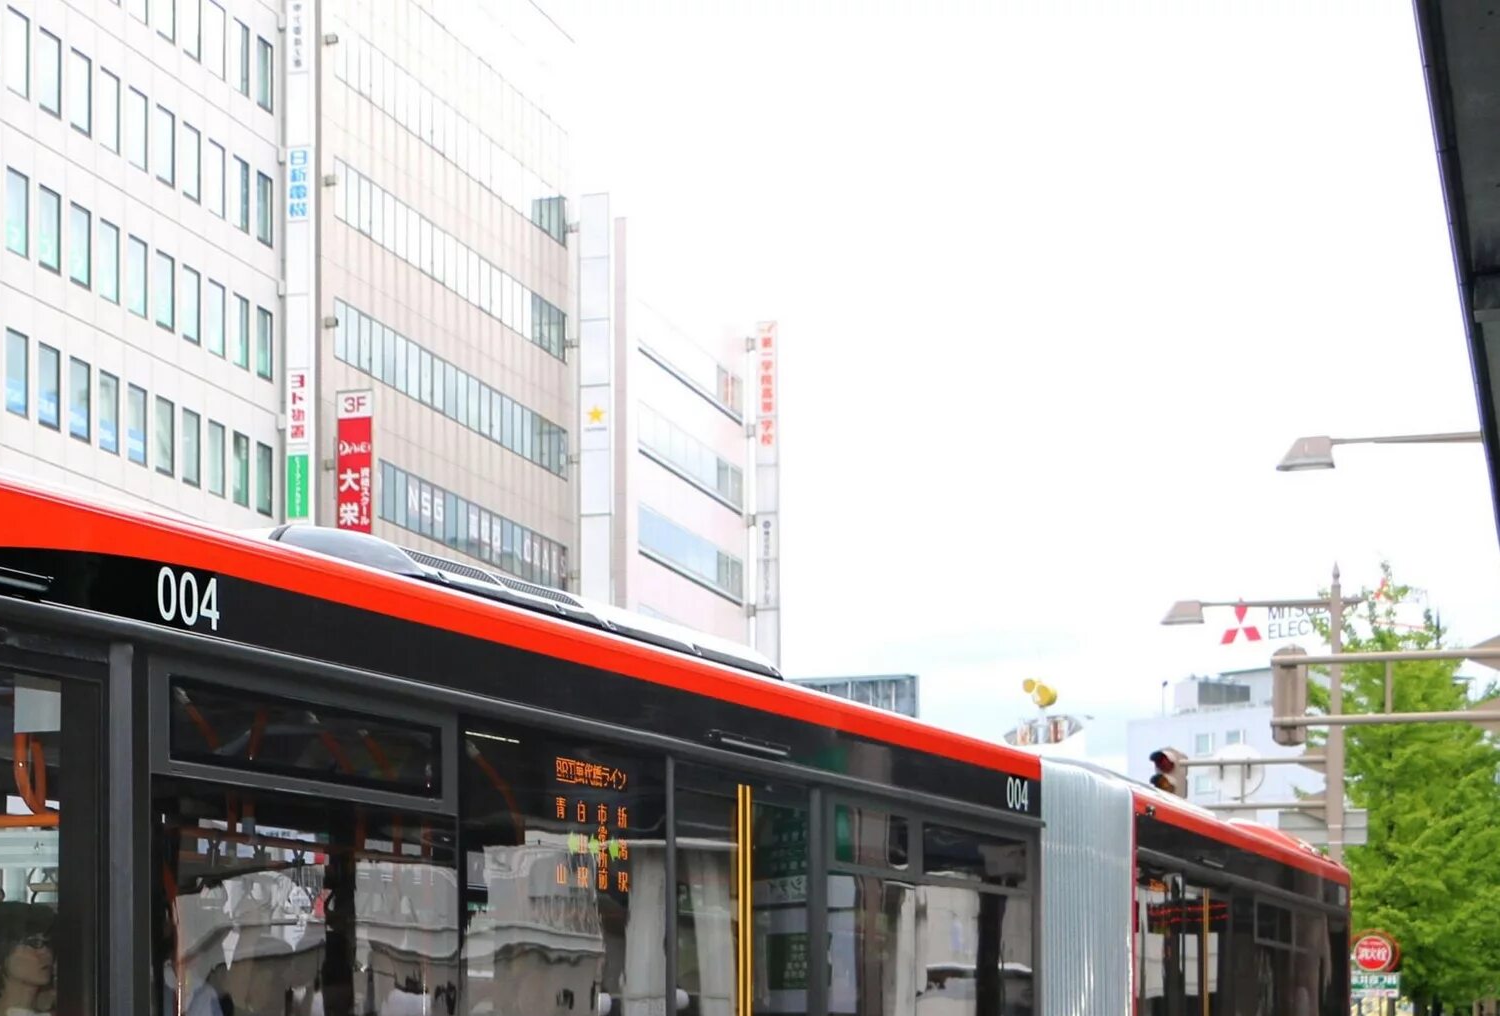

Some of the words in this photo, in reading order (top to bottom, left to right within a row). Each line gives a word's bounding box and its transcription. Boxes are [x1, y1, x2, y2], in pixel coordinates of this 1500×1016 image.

[344, 396, 367, 414] 3F
[339, 468, 361, 526] 大栄
[407, 483, 444, 522] NSG
[157, 566, 220, 631] 004
[1007, 776, 1028, 812] 004
